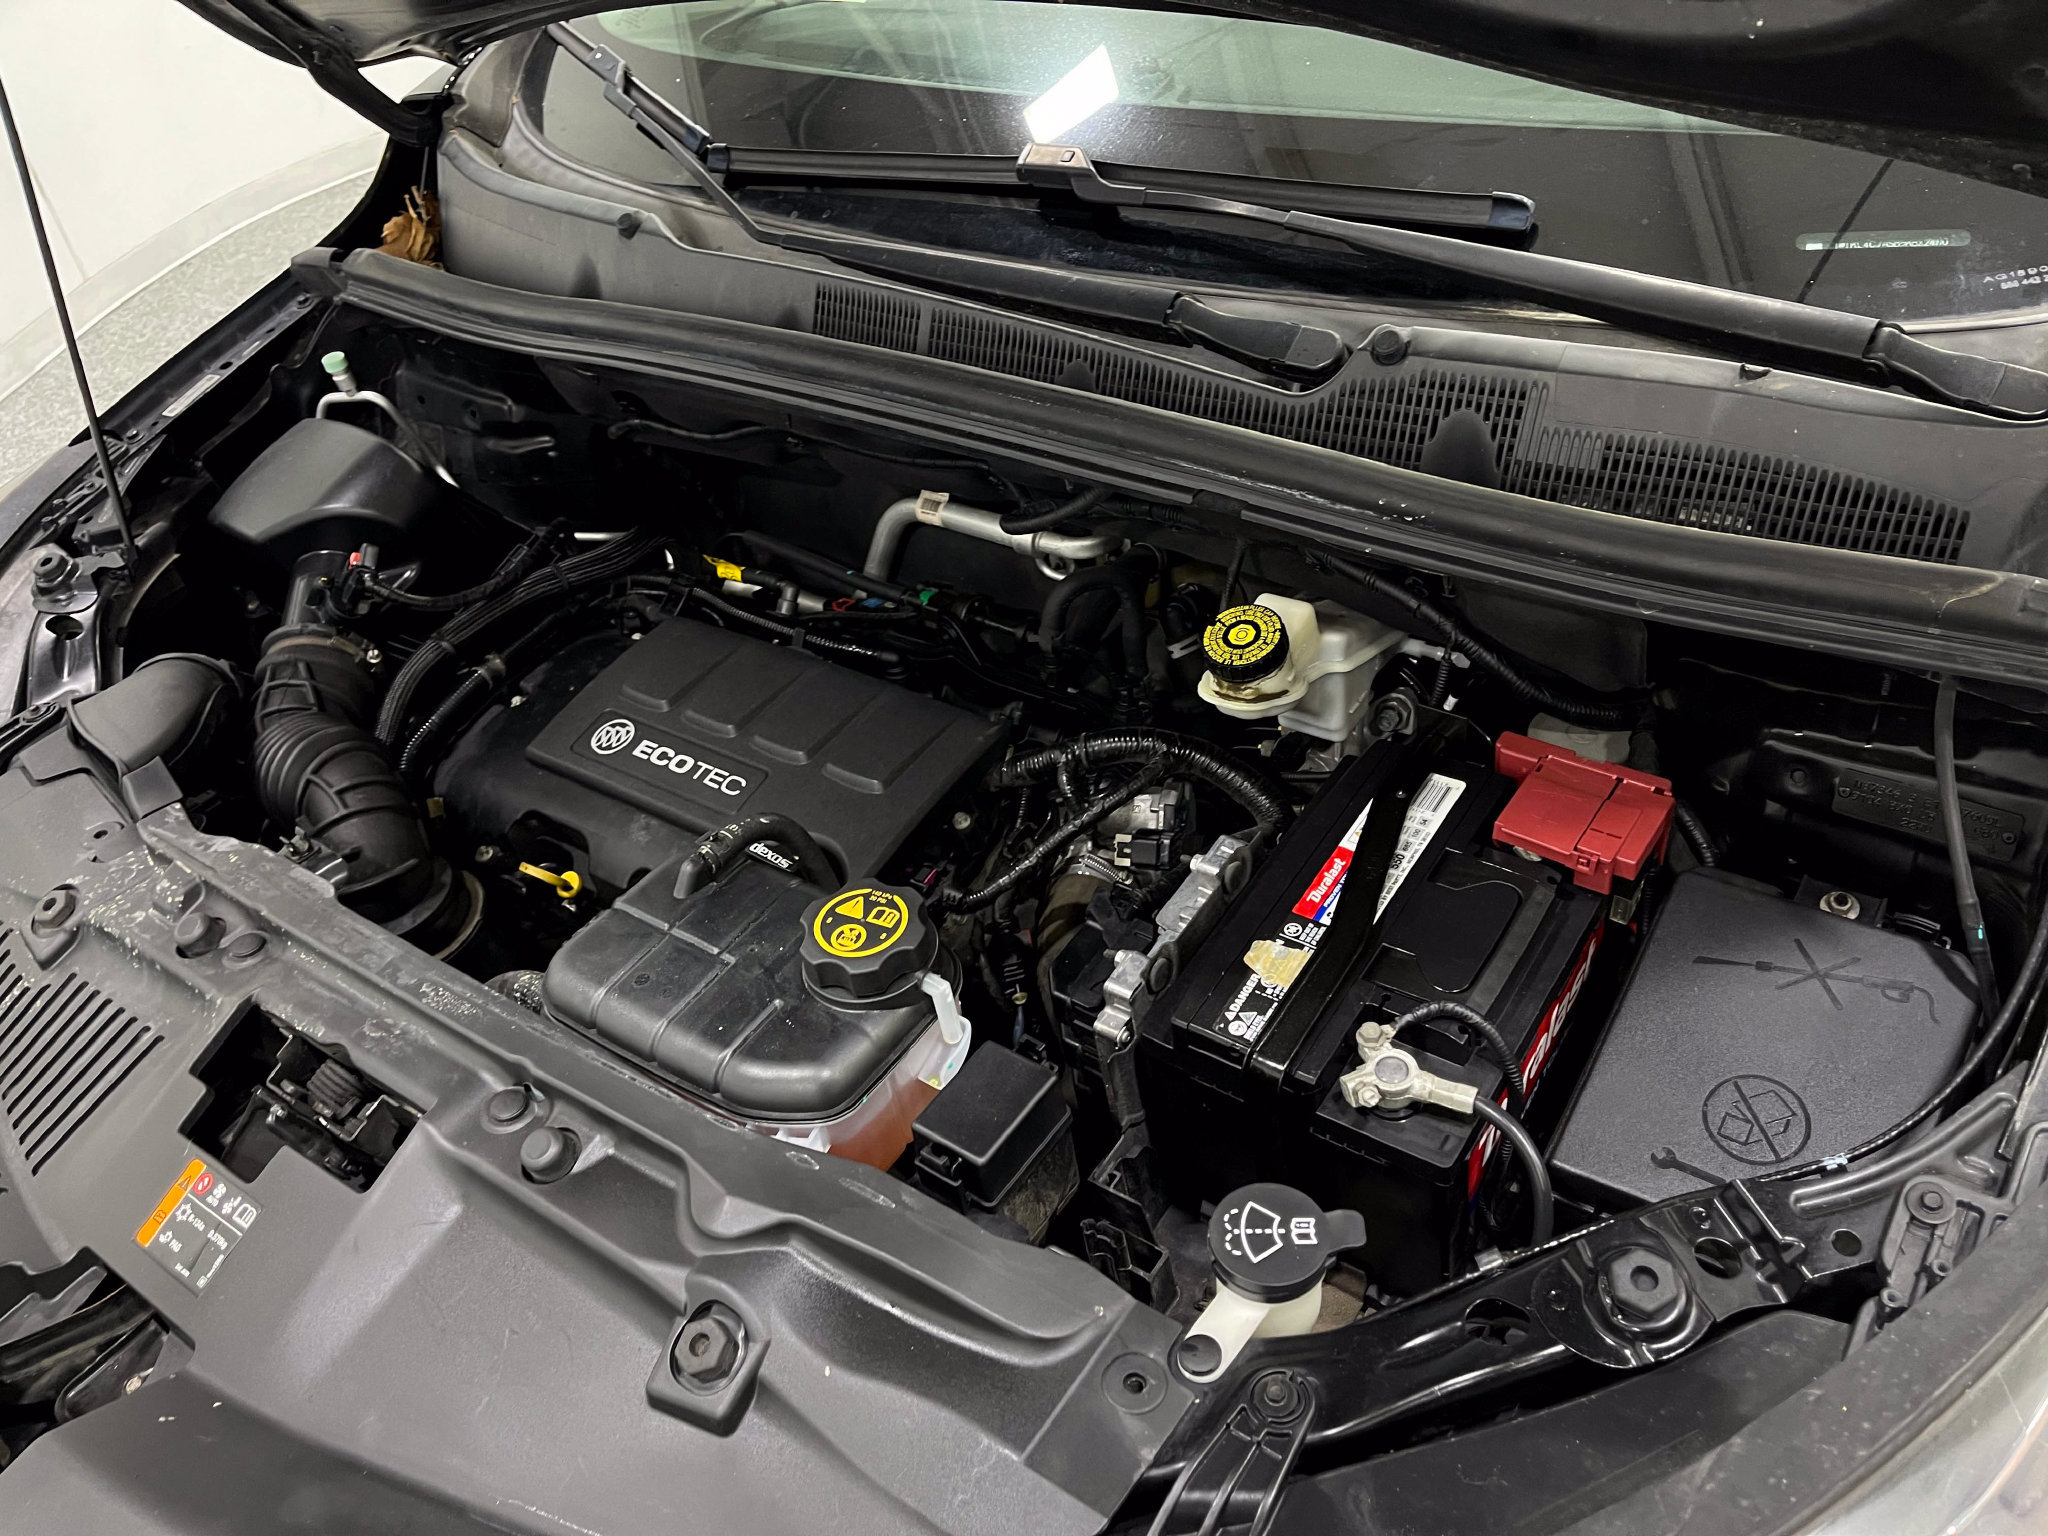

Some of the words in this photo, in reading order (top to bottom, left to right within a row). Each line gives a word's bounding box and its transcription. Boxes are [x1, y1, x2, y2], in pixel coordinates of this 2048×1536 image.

[632, 740, 748, 797] ECOTEC
[749, 842, 793, 869] dexos
[1391, 853, 1405, 870] 550
[1411, 828, 1421, 838] 100
[1306, 858, 1346, 903] Duralast
[1323, 883, 1343, 908] PROVEN
[1229, 973, 1261, 1014] DANGER
